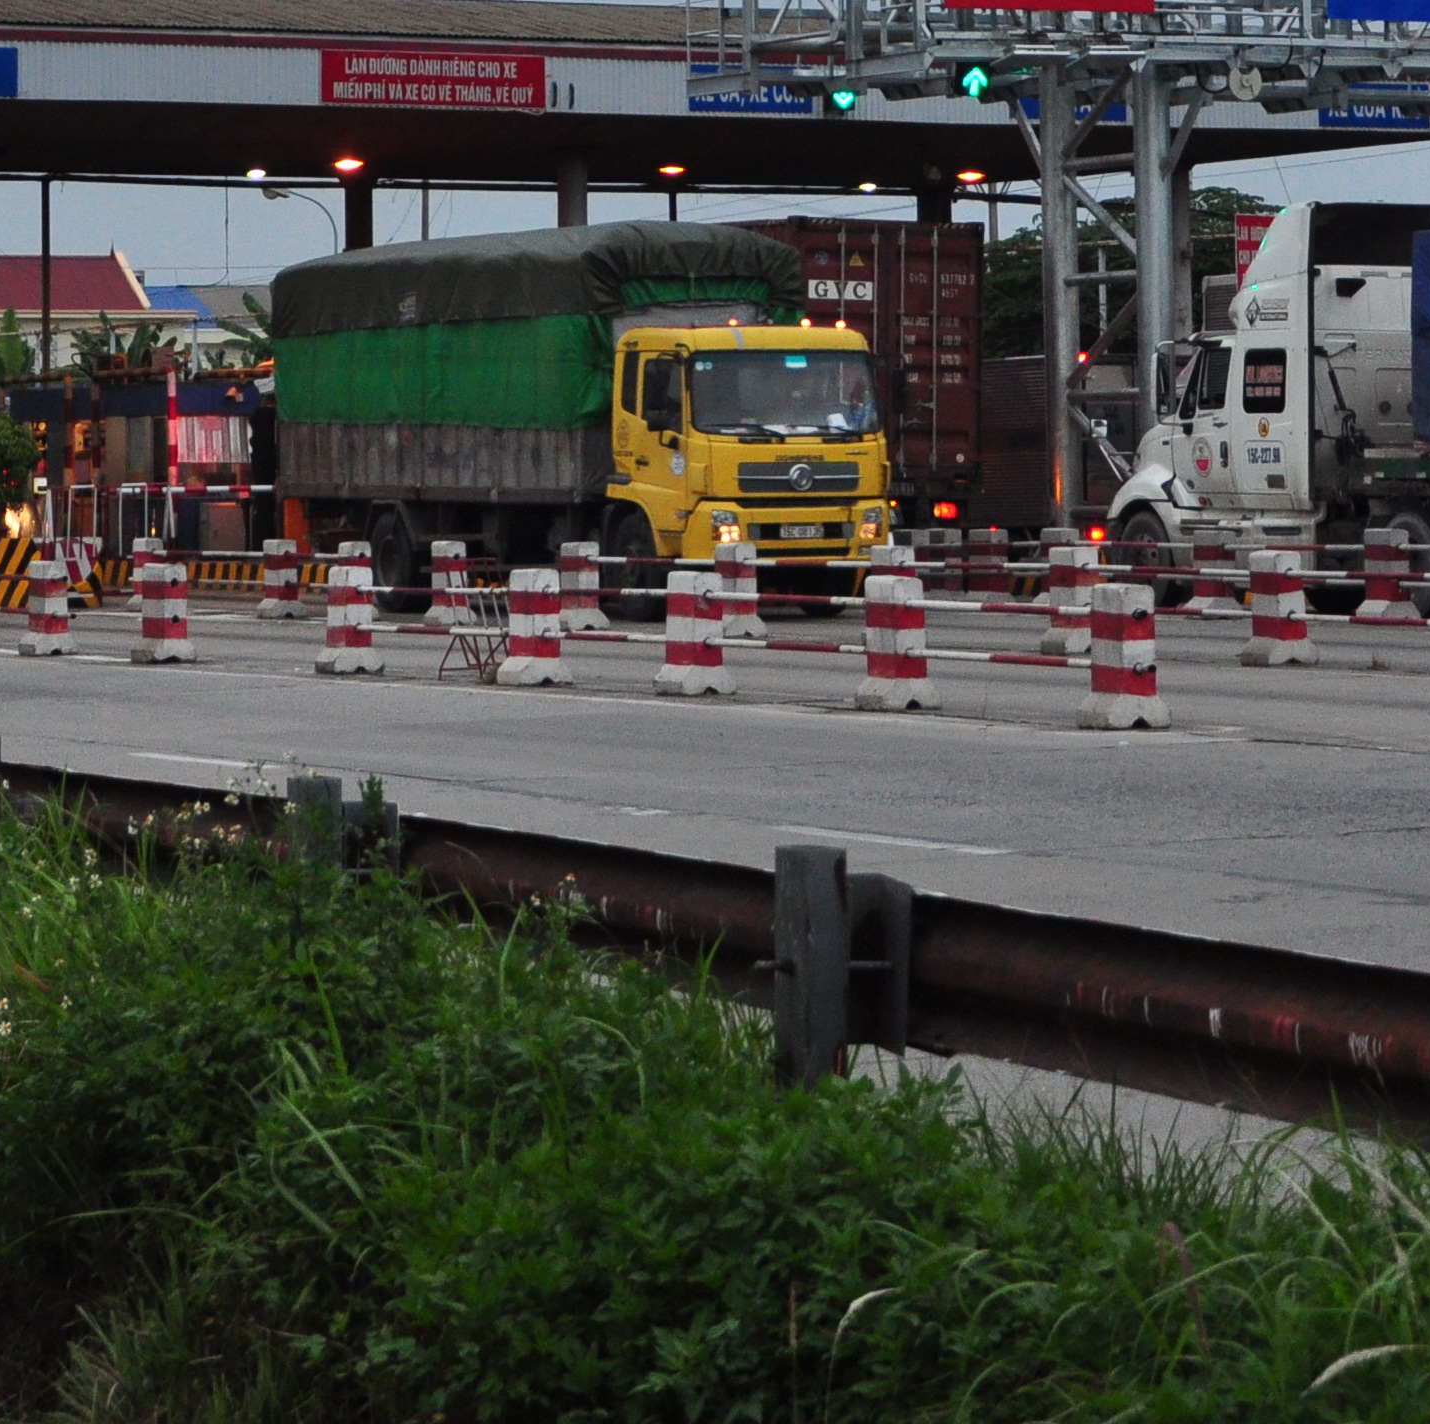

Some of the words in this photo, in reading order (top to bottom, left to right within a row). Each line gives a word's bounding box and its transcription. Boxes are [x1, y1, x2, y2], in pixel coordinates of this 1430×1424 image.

[478, 61, 501, 78] CHO
[503, 61, 518, 79] XE
[364, 79, 386, 100] PHÍ
[405, 83, 419, 101] XE
[421, 79, 436, 102] CÓ
[814, 281, 868, 299] GVC
